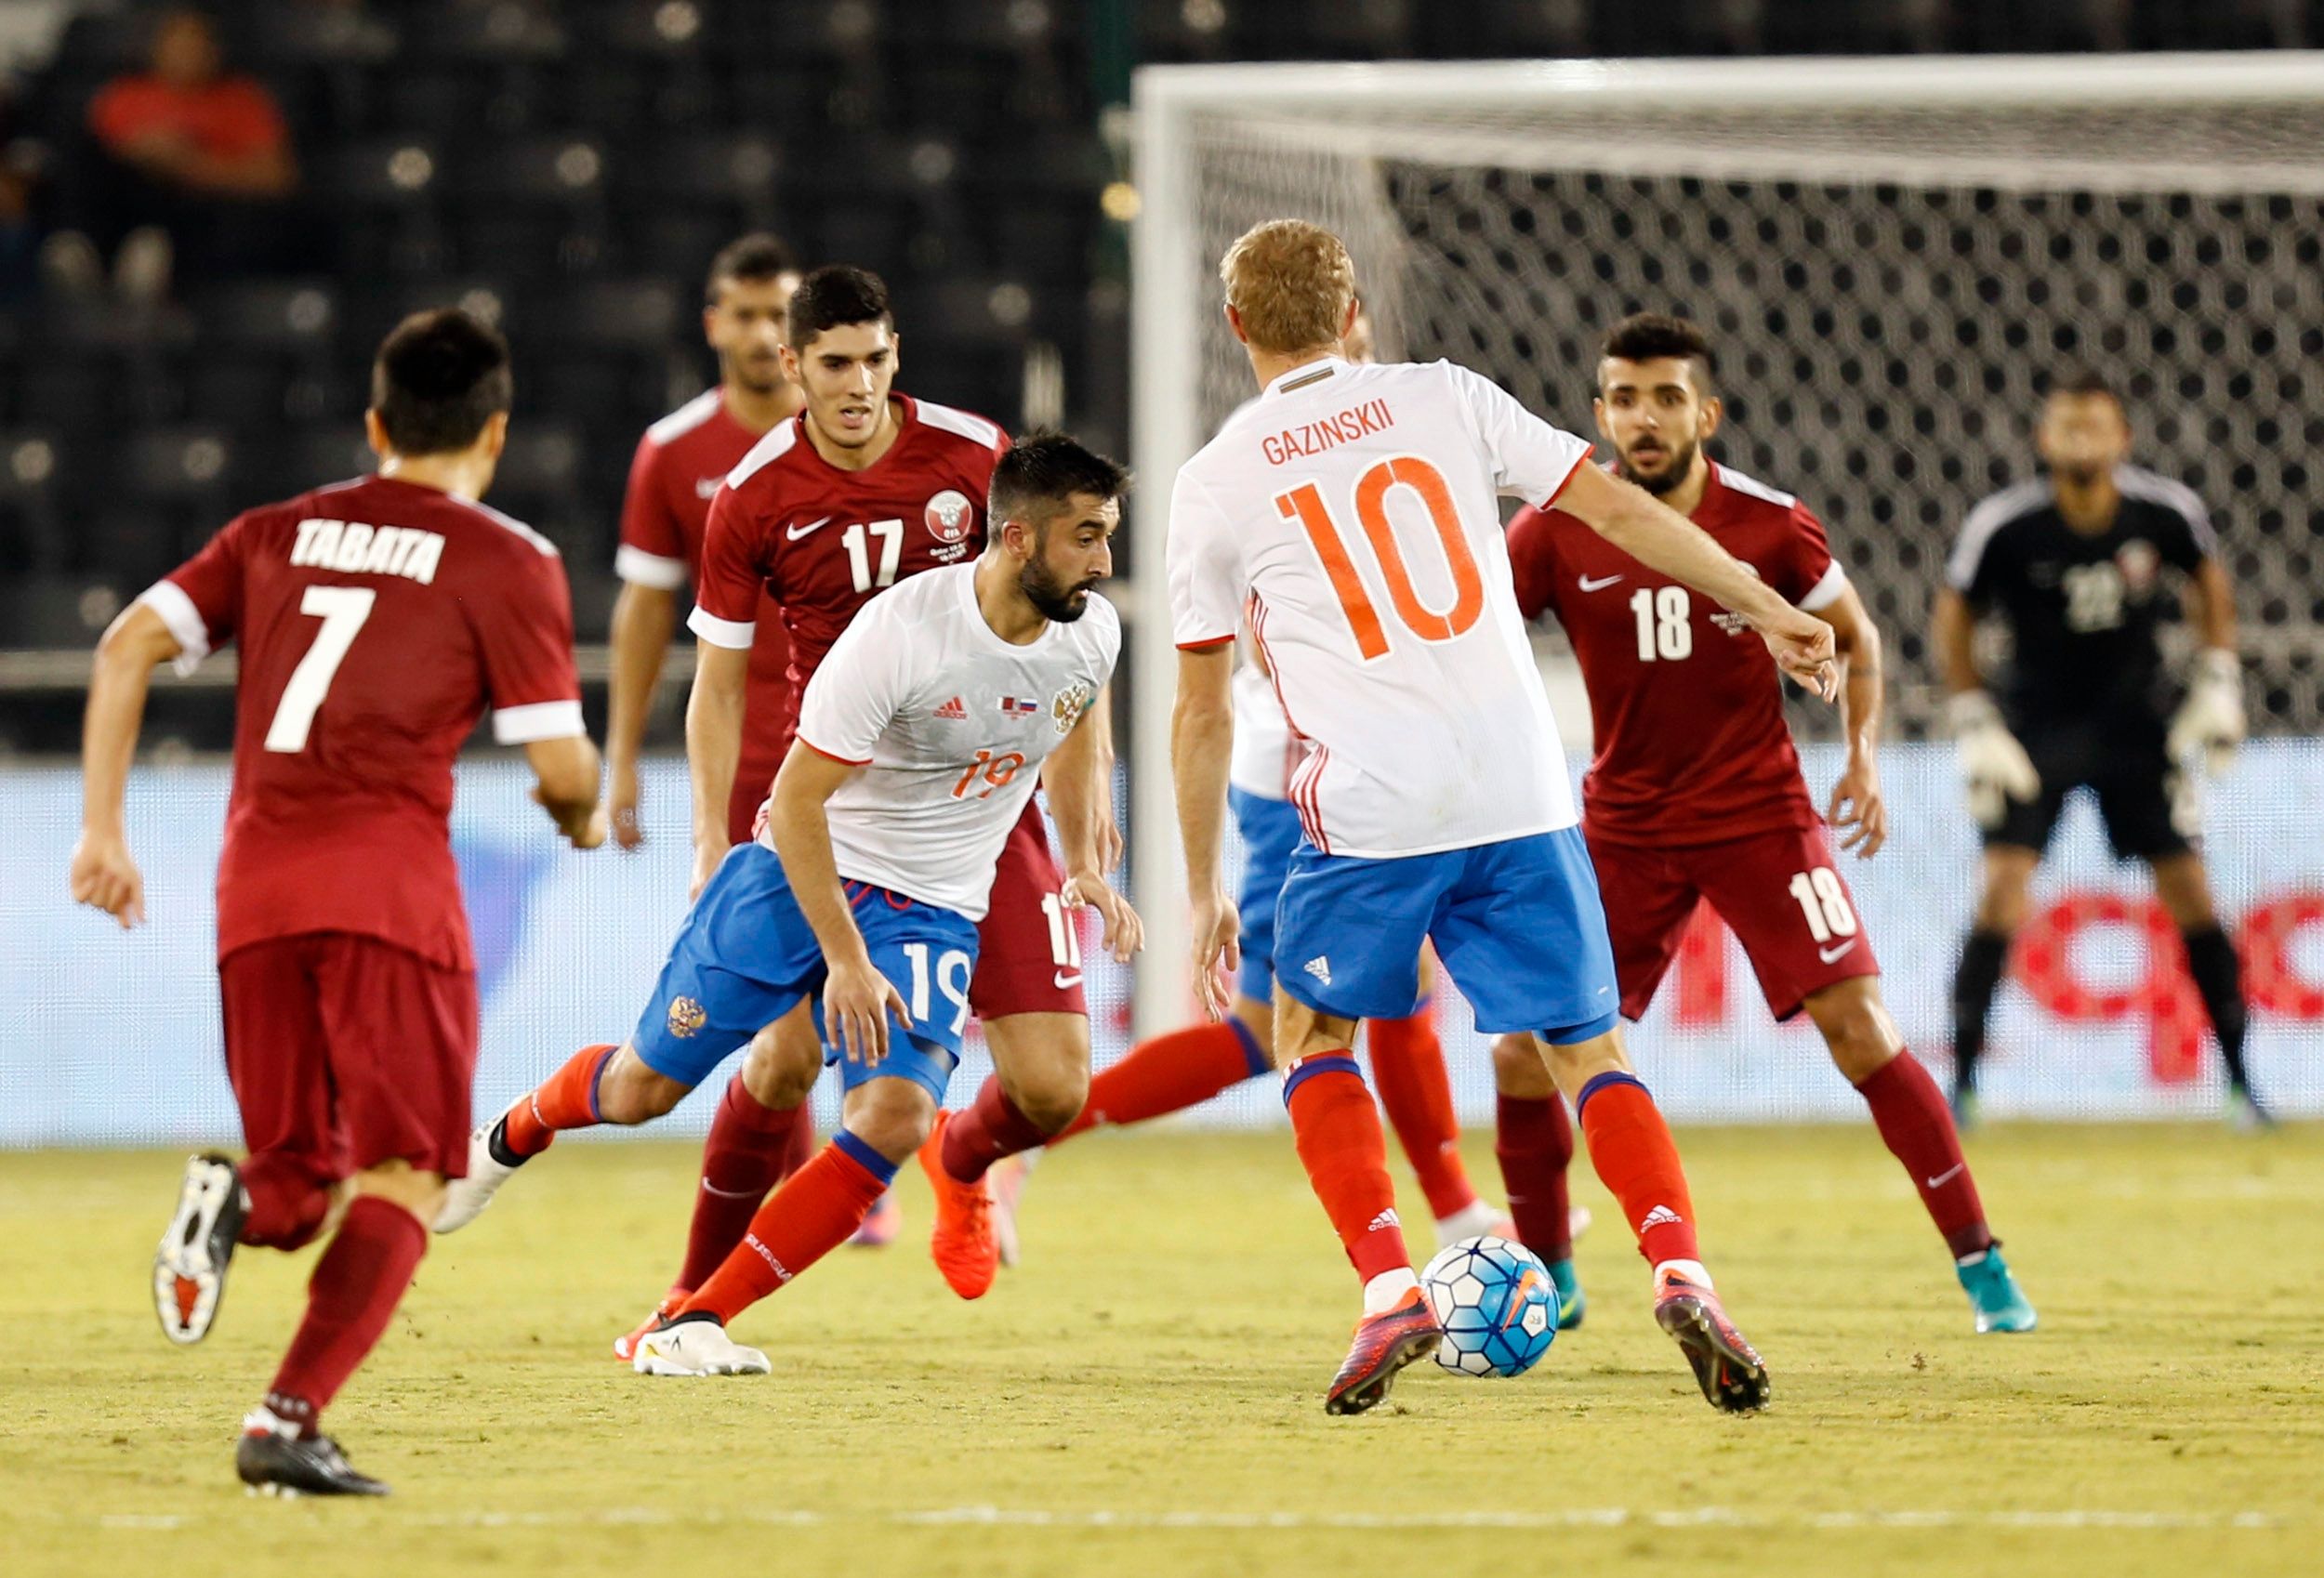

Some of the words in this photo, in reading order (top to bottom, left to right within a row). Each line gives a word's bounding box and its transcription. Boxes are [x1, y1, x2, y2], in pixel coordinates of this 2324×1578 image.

[1261, 398, 1395, 467] GAZINSKII
[289, 519, 446, 585] TABATA
[841, 519, 905, 594] 17
[1271, 452, 1487, 664] 10
[1629, 585, 1692, 663] 18
[264, 585, 377, 754] 7
[951, 748, 1026, 801] 19
[1788, 866, 1857, 943] 18
[903, 942, 971, 1038] 19
